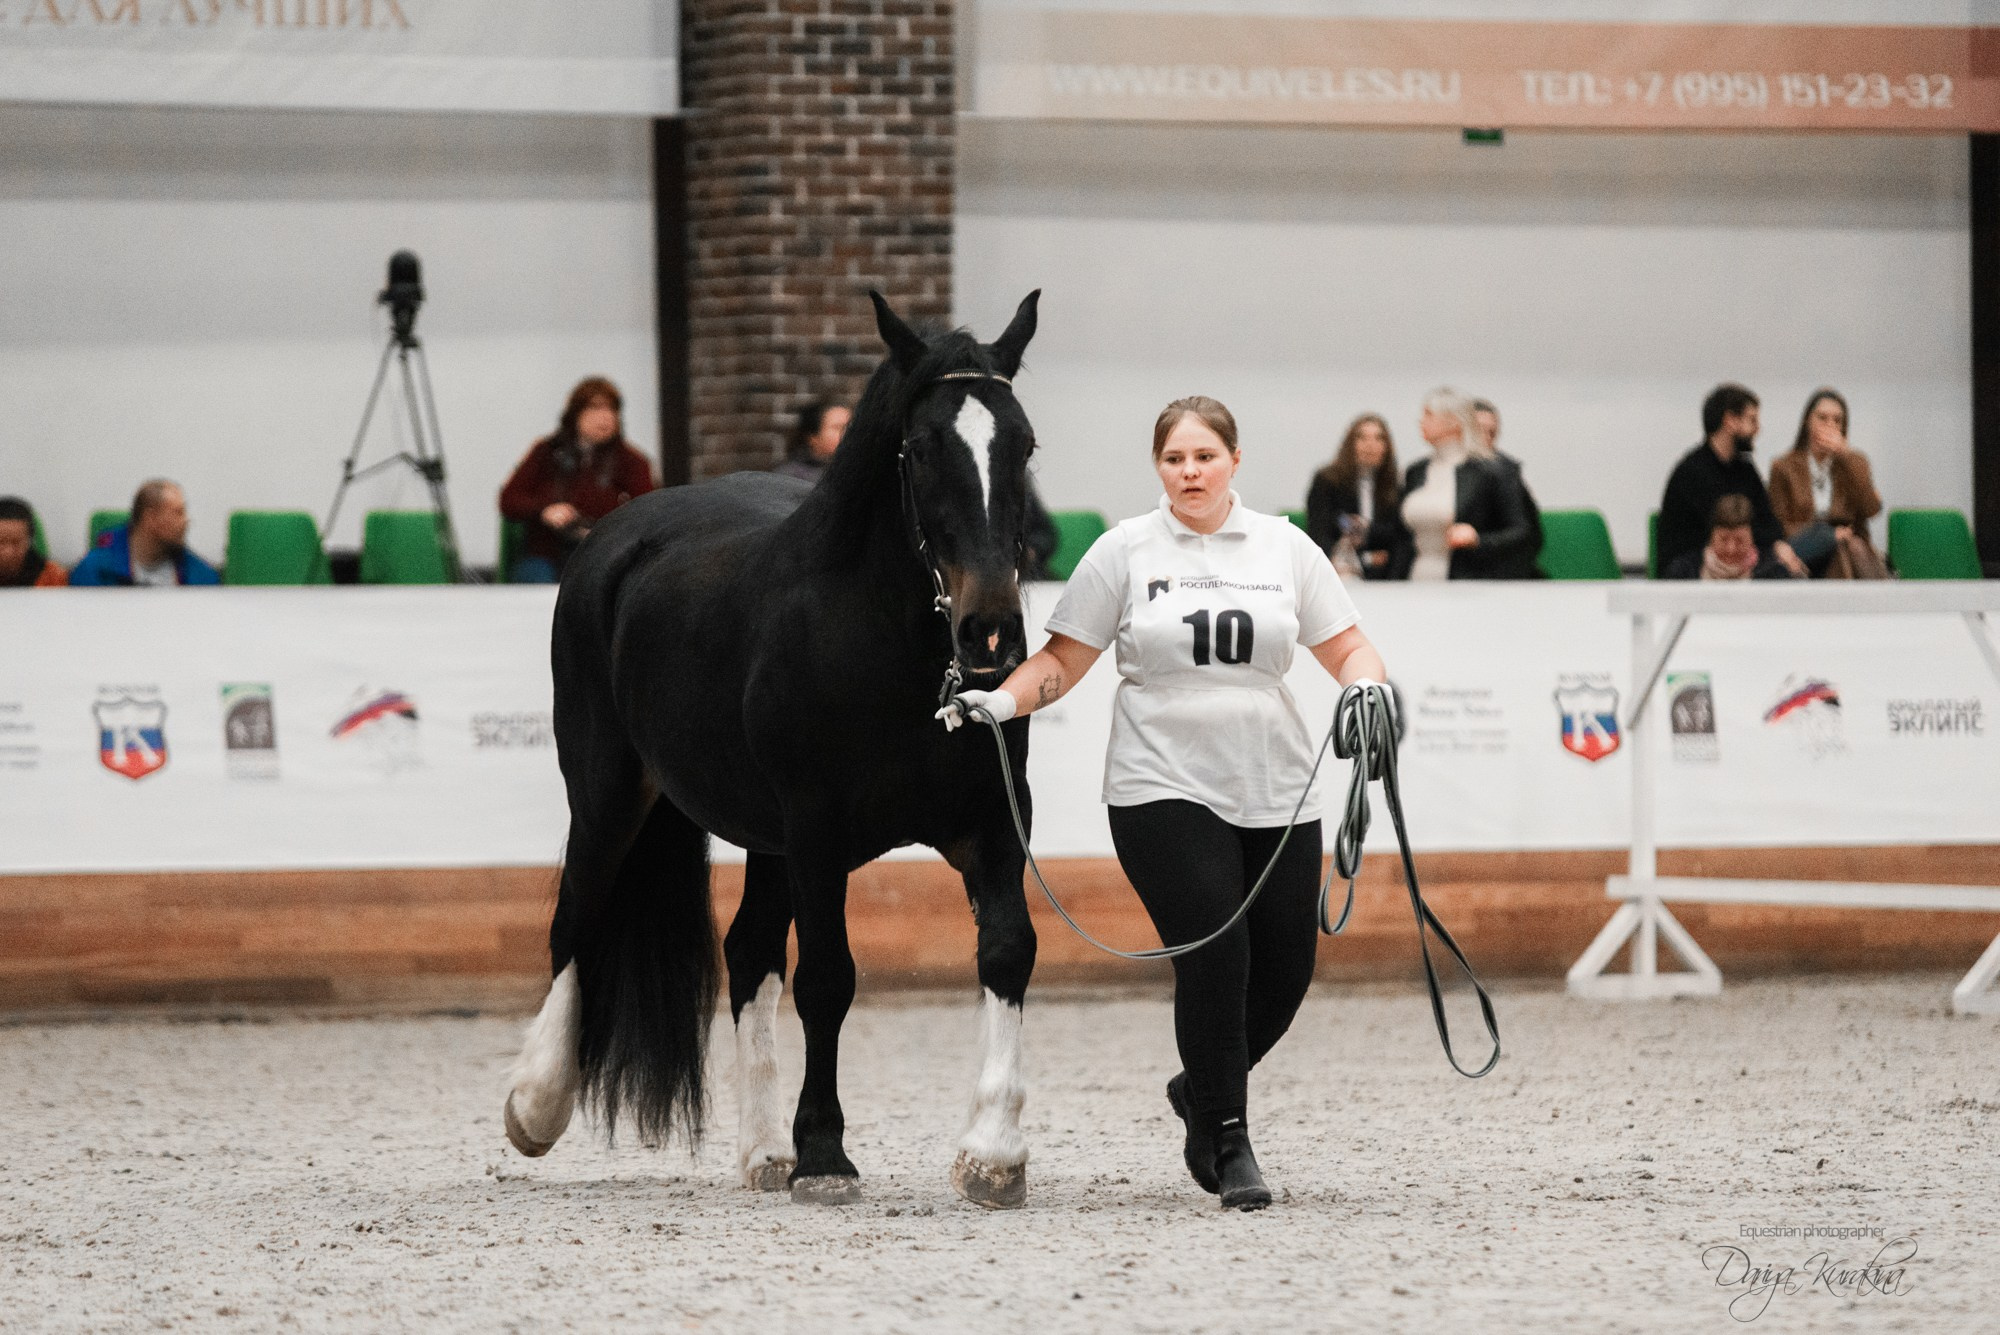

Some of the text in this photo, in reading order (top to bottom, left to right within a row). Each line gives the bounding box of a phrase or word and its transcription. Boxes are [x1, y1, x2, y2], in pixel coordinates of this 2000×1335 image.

[1623, 71, 1664, 107] +7
[1672, 71, 1768, 110] (995)
[1777, 73, 1955, 110] 151-23-32
[1180, 580, 1283, 593] РОСПЛЕМКОНЗАВОД
[1182, 608, 1254, 667] 10
[1888, 711, 1985, 735] ЭКЛИПС
